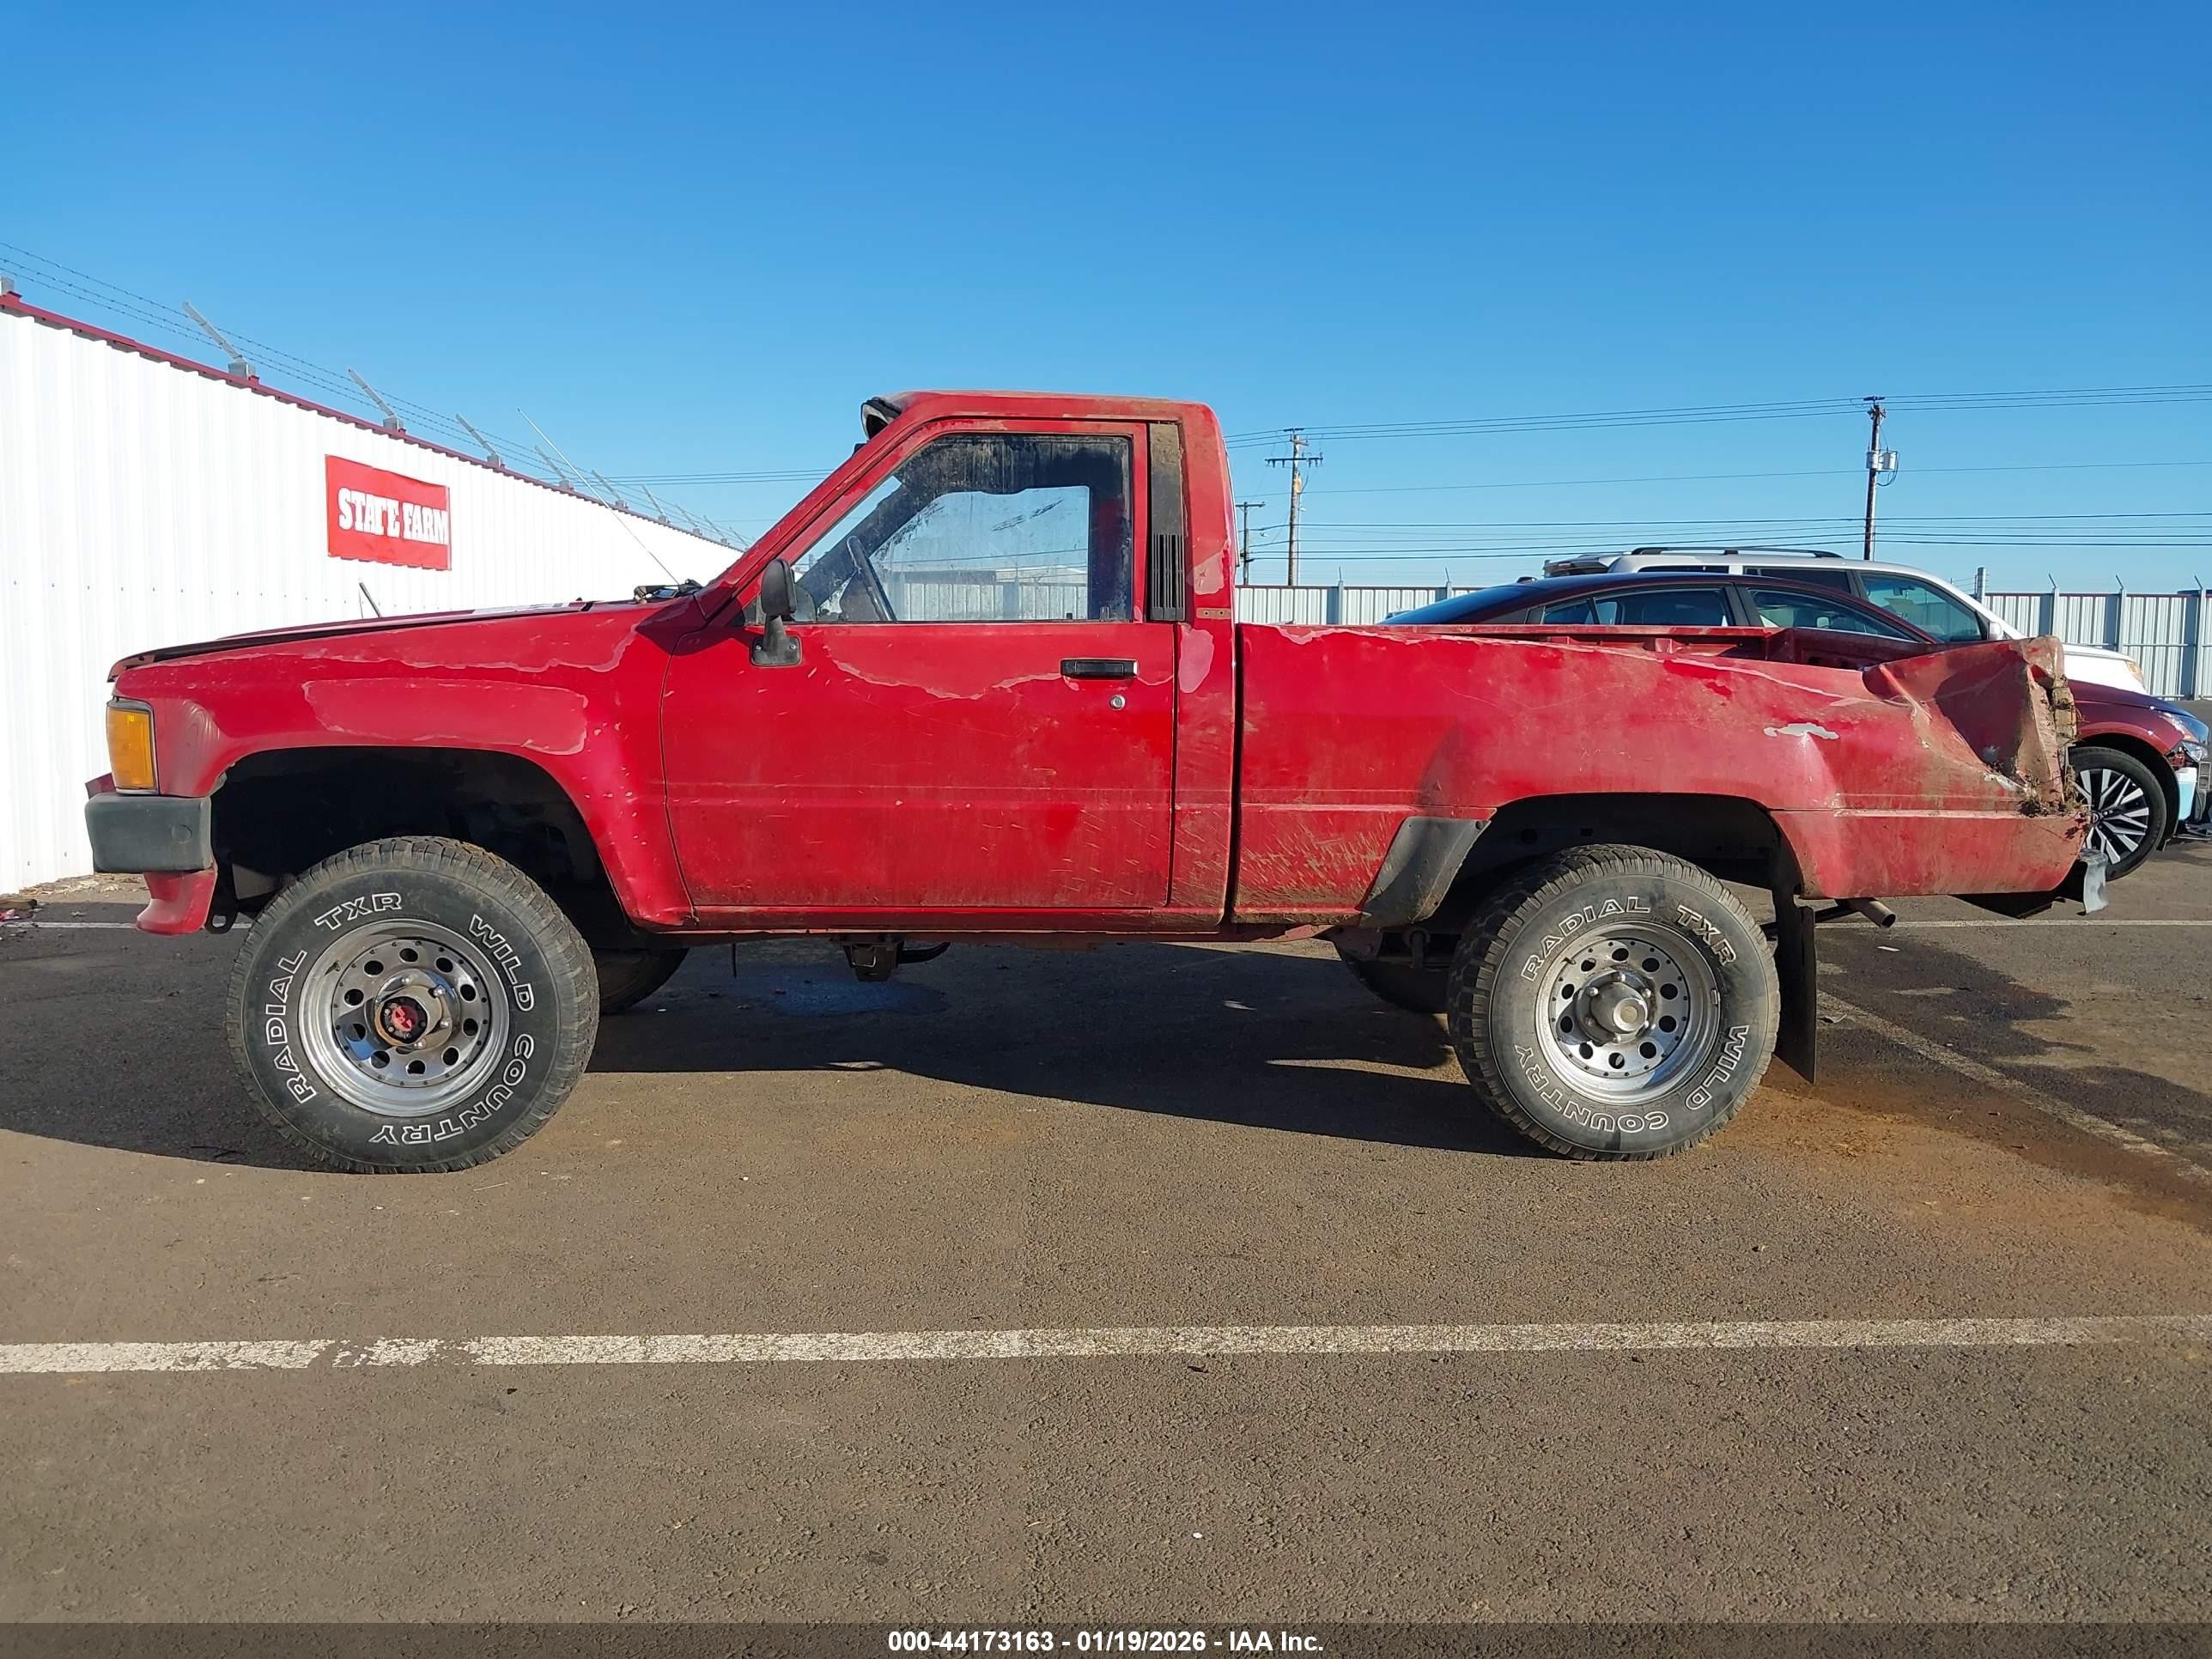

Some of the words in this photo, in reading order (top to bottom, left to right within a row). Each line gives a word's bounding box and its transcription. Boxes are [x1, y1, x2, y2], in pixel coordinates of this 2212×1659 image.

[337, 486, 400, 538] STATE
[402, 501, 448, 545] FARM
[467, 913, 535, 1012] WILD
[1521, 896, 1651, 981] RADIAL
[1675, 904, 1738, 967] TXR
[264, 948, 318, 1105] RADIAL
[313, 891, 403, 931] TXR
[368, 1033, 535, 1146] COUNTRY
[1514, 1043, 1669, 1133] COUNTRY
[1684, 1024, 1751, 1111] WILD
